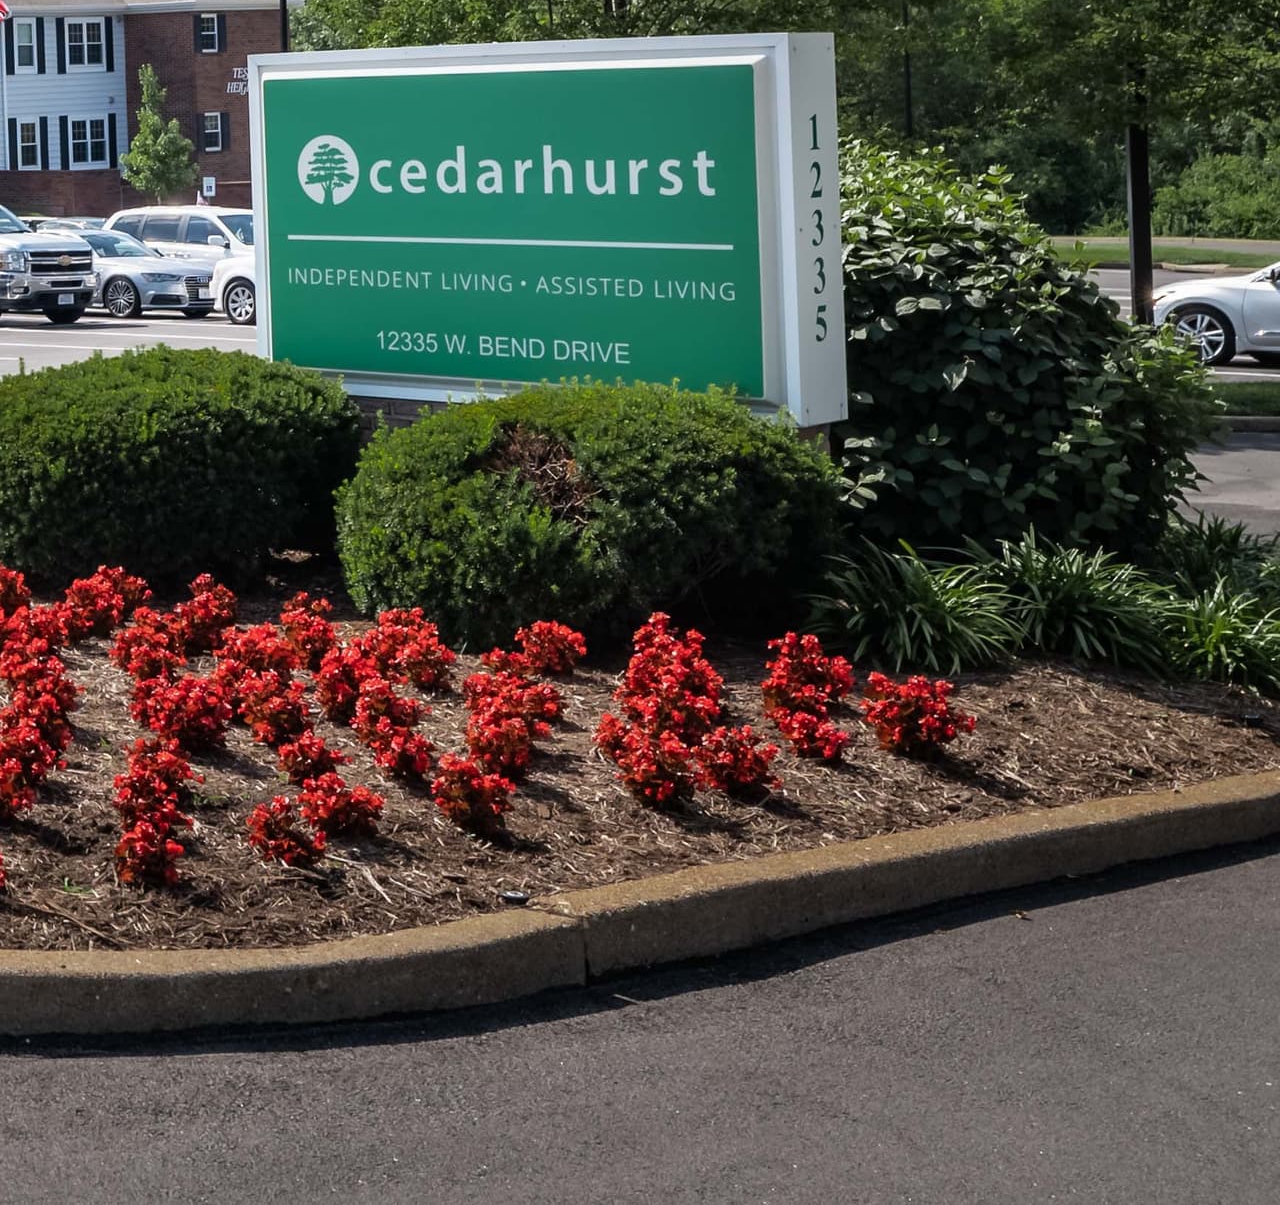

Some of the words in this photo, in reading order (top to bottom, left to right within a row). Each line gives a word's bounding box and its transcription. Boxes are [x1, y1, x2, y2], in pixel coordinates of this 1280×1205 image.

[369, 144, 716, 197] cedarhurst
[808, 113, 828, 344] 12335
[288, 267, 432, 290] INDEPENDENT
[441, 272, 513, 294] LIVING
[536, 275, 644, 298] ASSISTED
[653, 279, 736, 302] LIVING
[376, 330, 439, 354] 12335
[444, 333, 472, 356] W.
[478, 335, 546, 361] BEND
[552, 338, 631, 365] DRIVE
